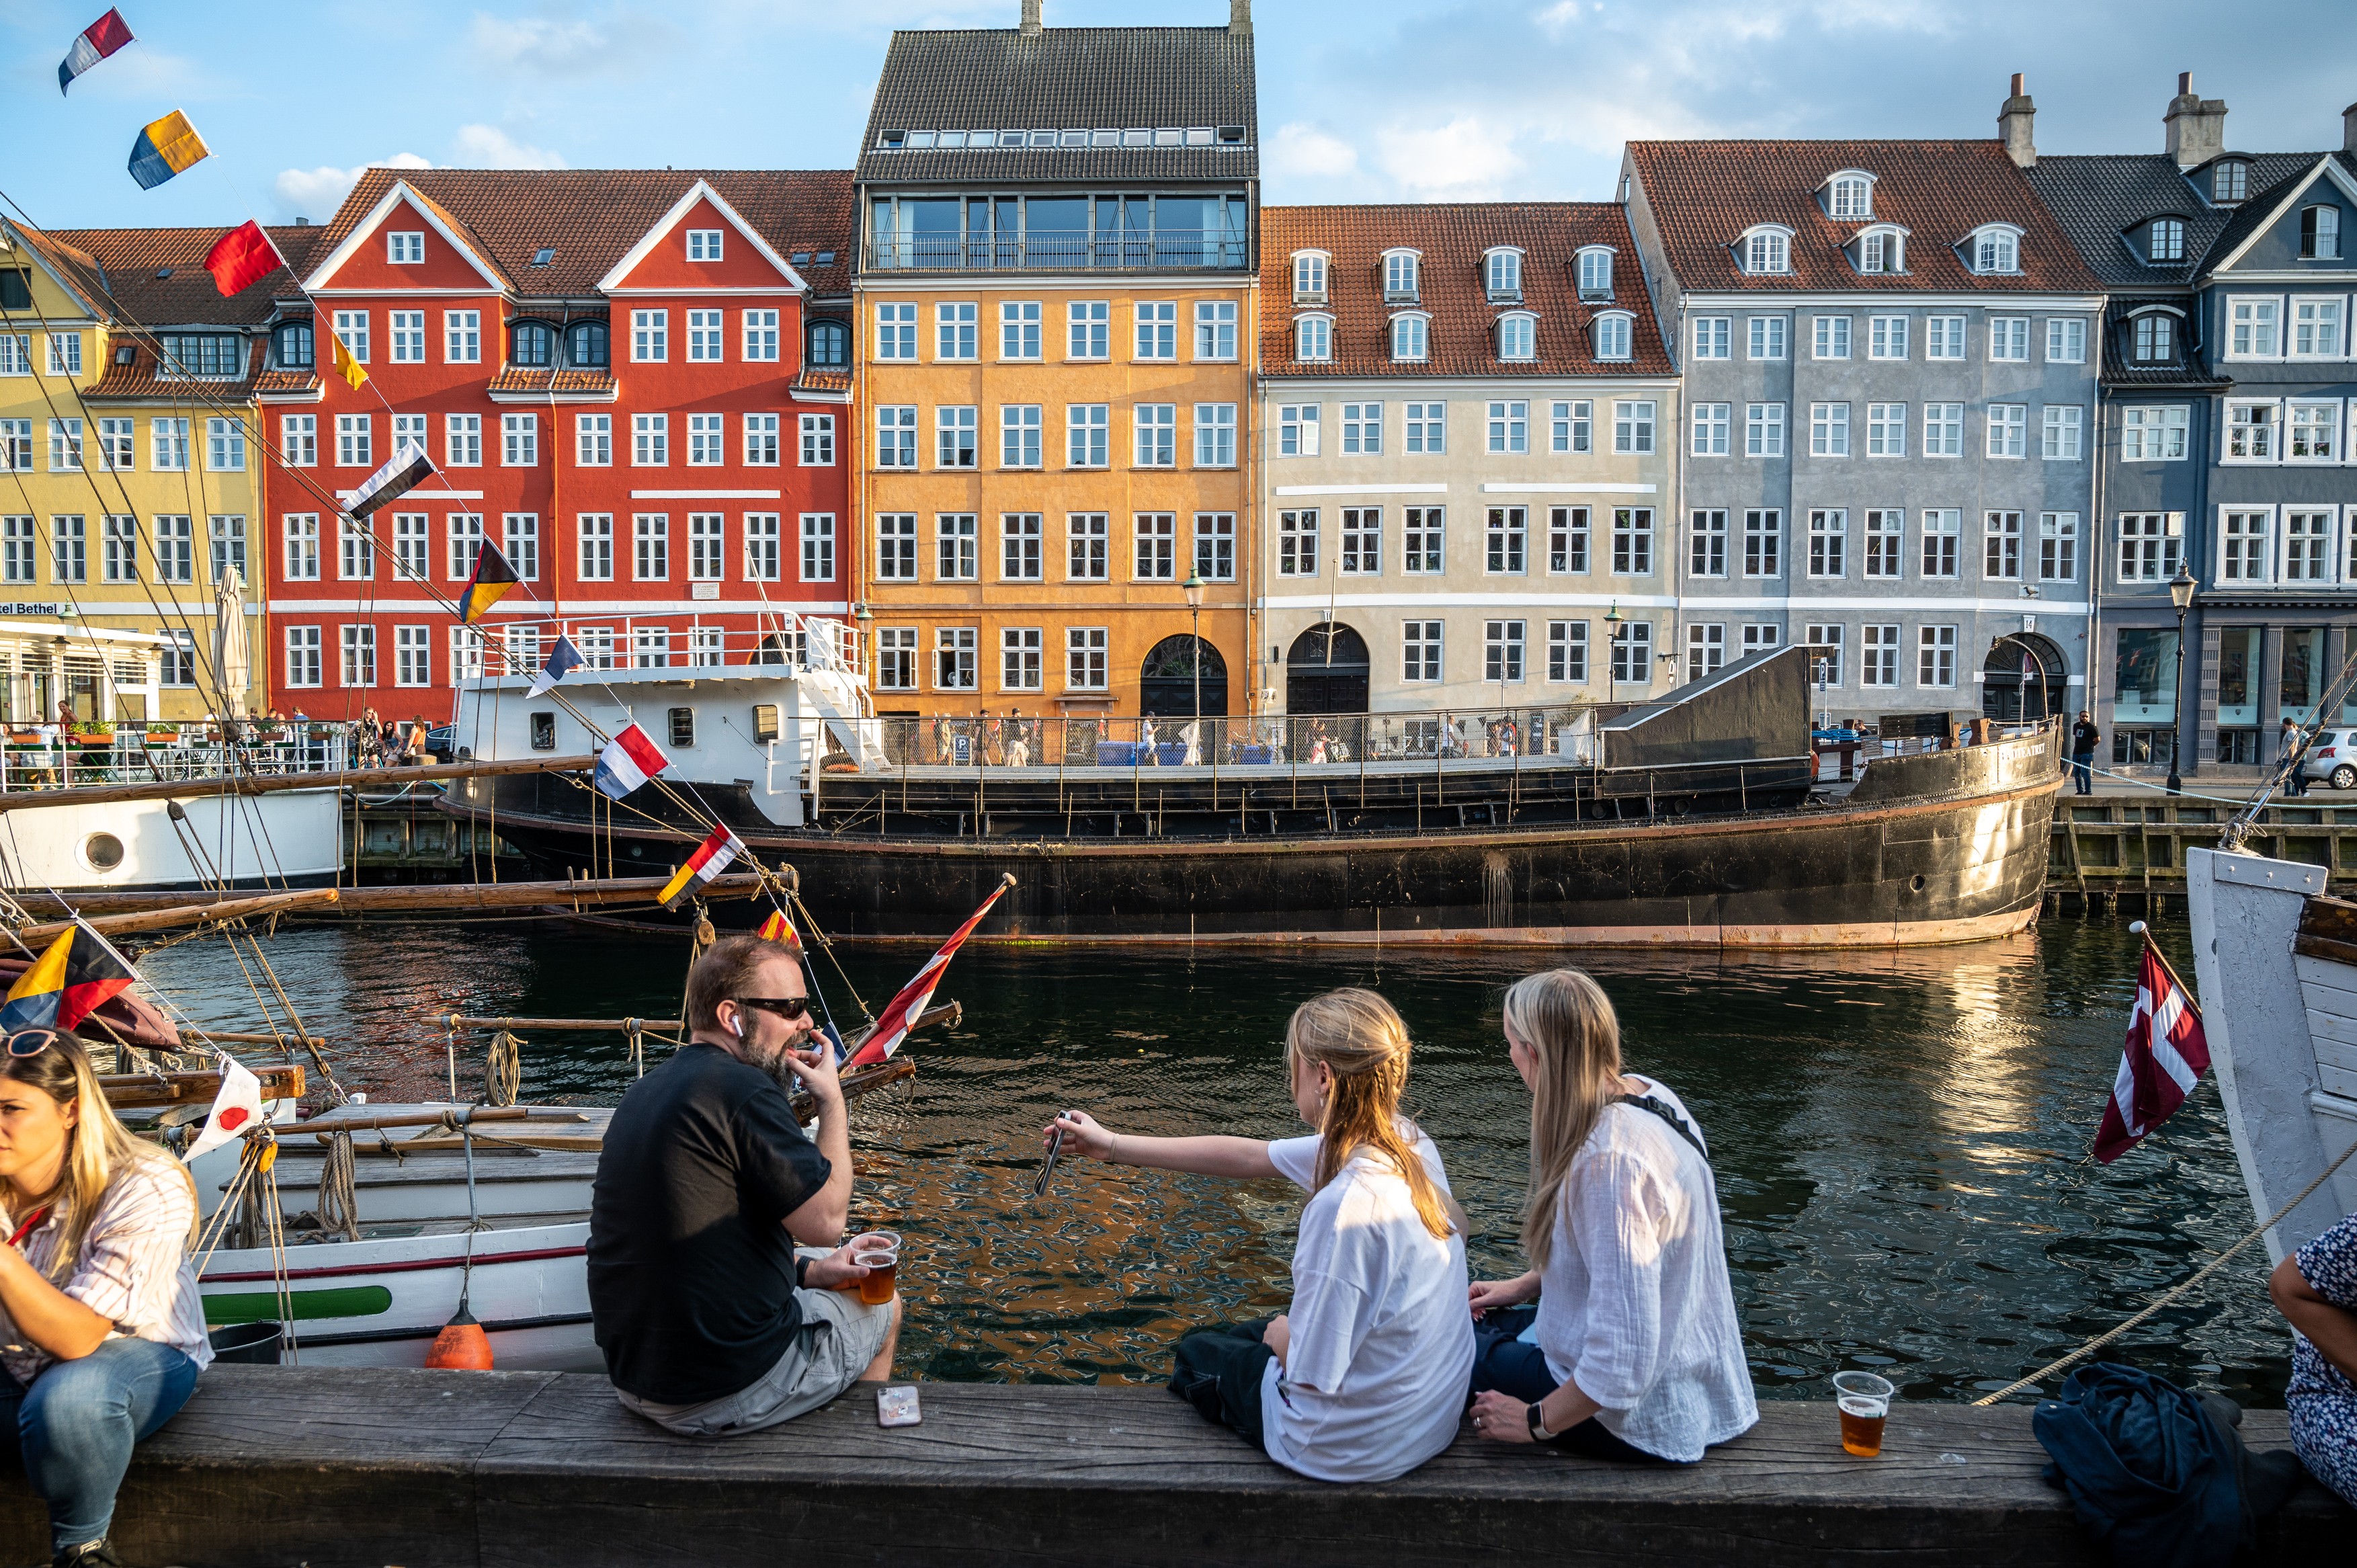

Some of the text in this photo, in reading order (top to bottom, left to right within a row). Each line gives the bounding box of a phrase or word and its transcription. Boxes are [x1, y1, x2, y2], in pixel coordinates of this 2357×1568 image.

[17, 604, 57, 614] Bethel
[2026, 620, 2032, 628] 14
[959, 739, 966, 749] P
